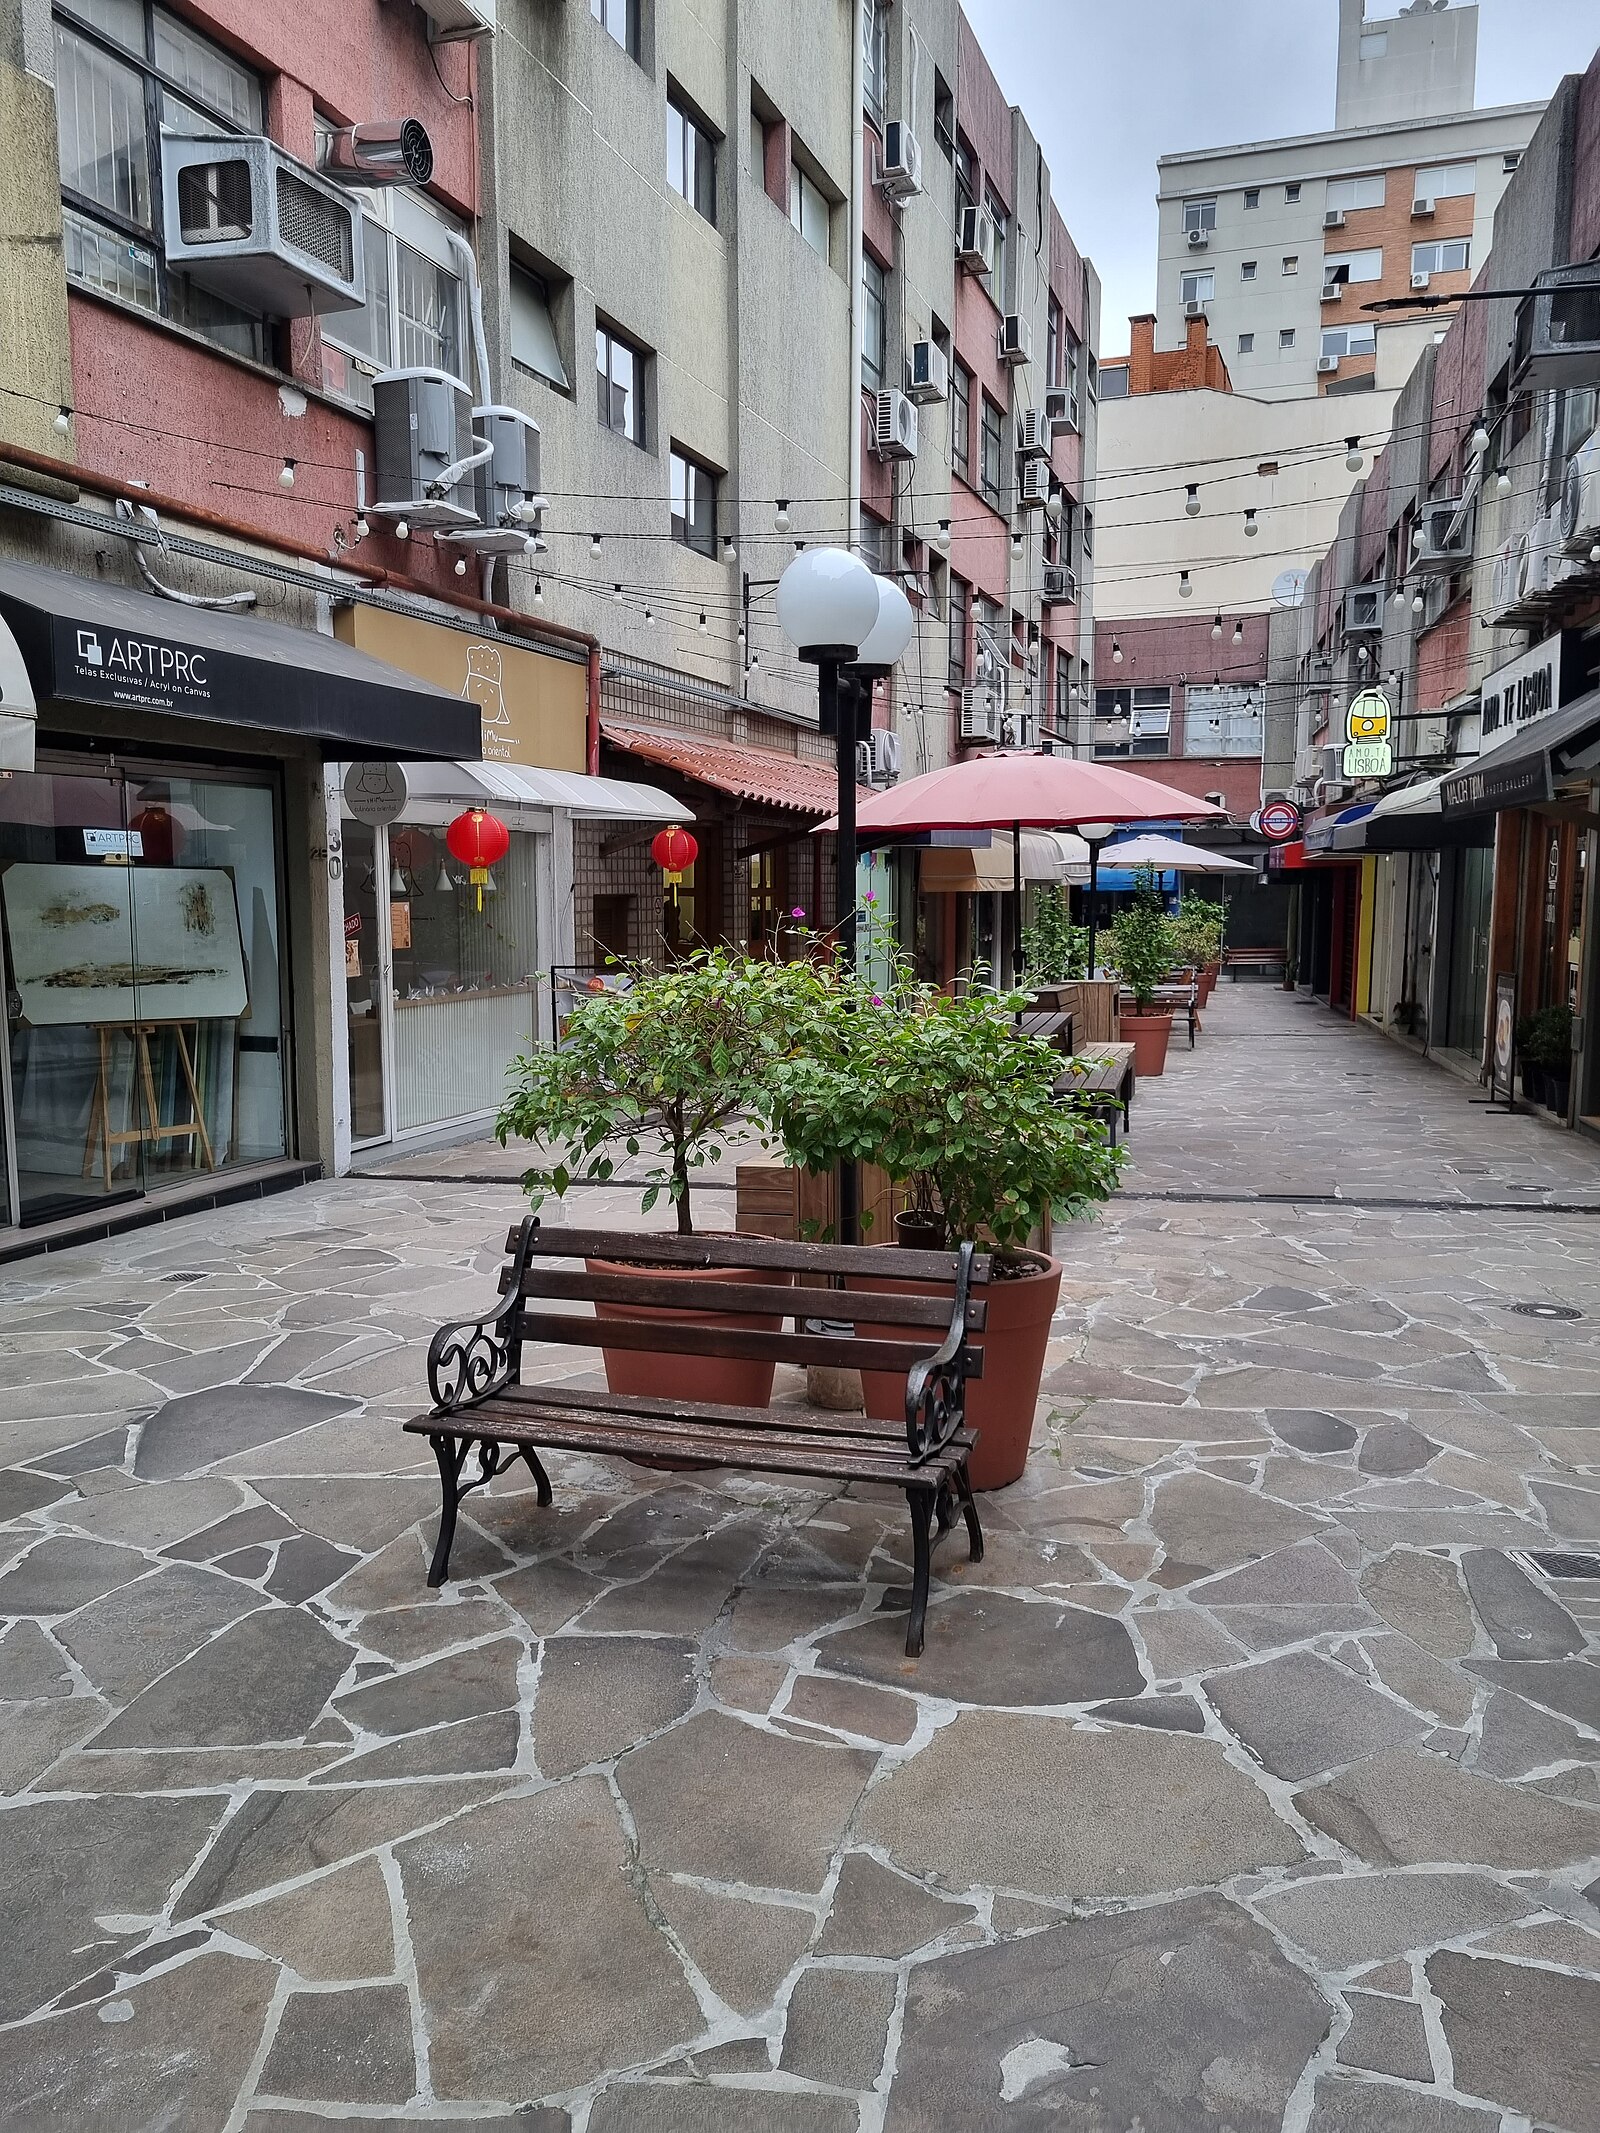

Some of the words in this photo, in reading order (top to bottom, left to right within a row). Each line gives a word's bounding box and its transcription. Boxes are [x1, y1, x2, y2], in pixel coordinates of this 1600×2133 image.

[108, 638, 207, 684] ARTPRC
[74, 665, 98, 678] Telas
[100, 670, 143, 686] Exclusivas
[144, 677, 148, 687] /
[150, 680, 170, 694] Acryl
[172, 685, 183, 693] on
[184, 686, 211, 698] Canvas
[113, 690, 174, 707] www.artprc.com.br
[1516, 662, 1552, 721] LISBOA
[487, 745, 512, 759] oriental
[1348, 758, 1387, 774] LISBOA
[1506, 774, 1534, 791] GALLERY
